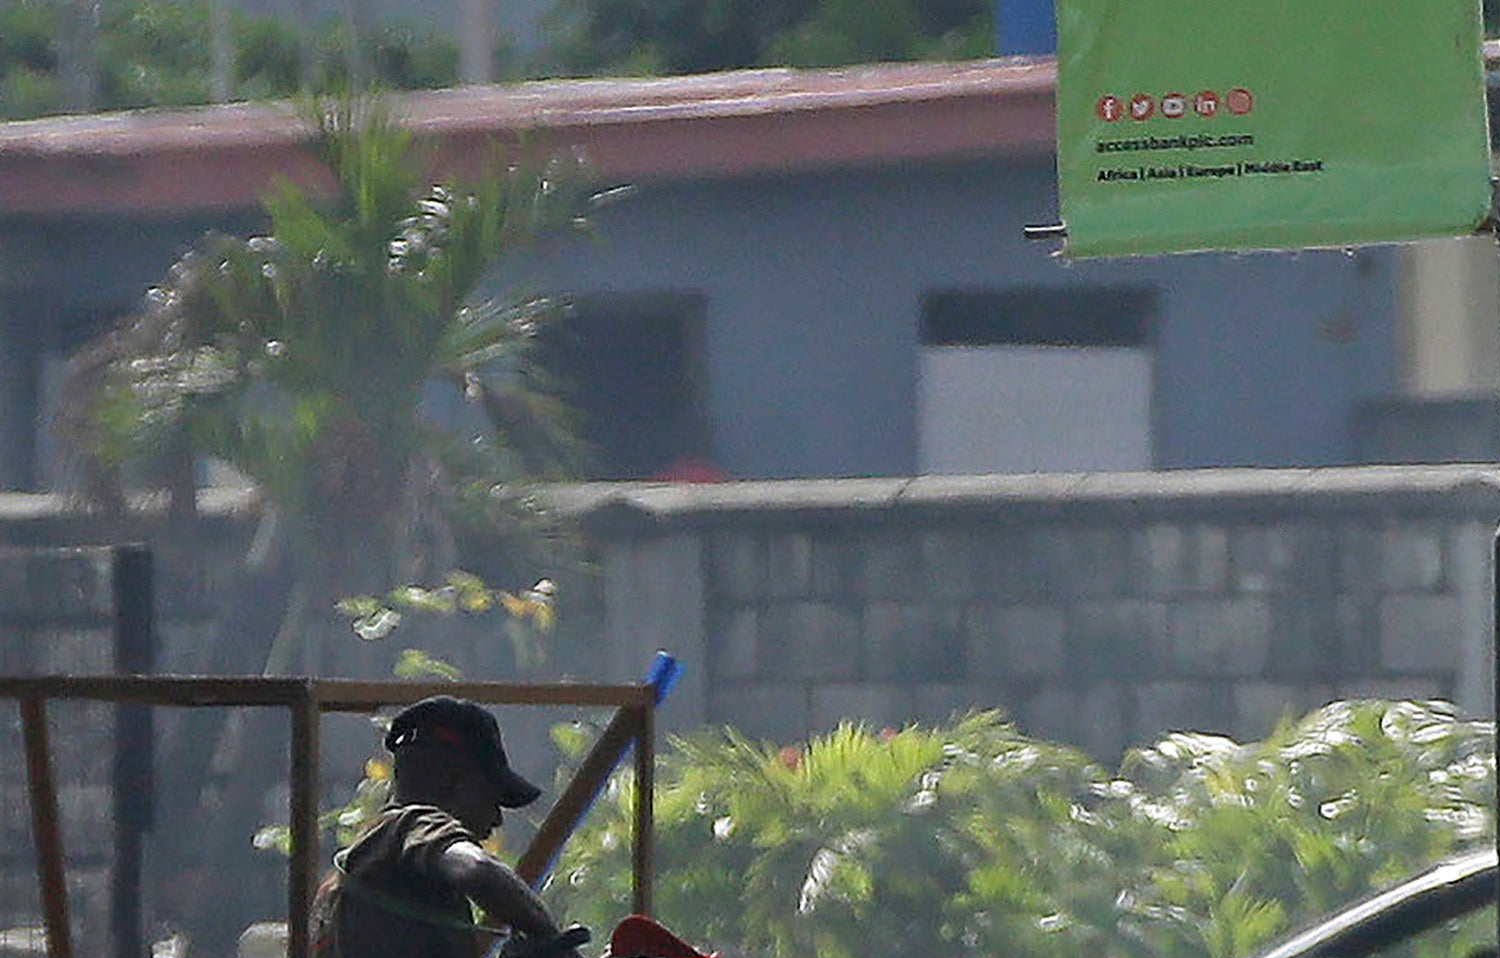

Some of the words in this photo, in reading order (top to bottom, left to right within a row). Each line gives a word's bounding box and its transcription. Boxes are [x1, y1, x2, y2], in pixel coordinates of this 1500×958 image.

[1095, 135, 1253, 154] accessbankplc.com
[1097, 168, 1138, 181] Africa
[1148, 167, 1177, 178] Asia
[1187, 165, 1234, 178] Europe
[1244, 162, 1290, 174] Middle
[1293, 161, 1321, 172] East
